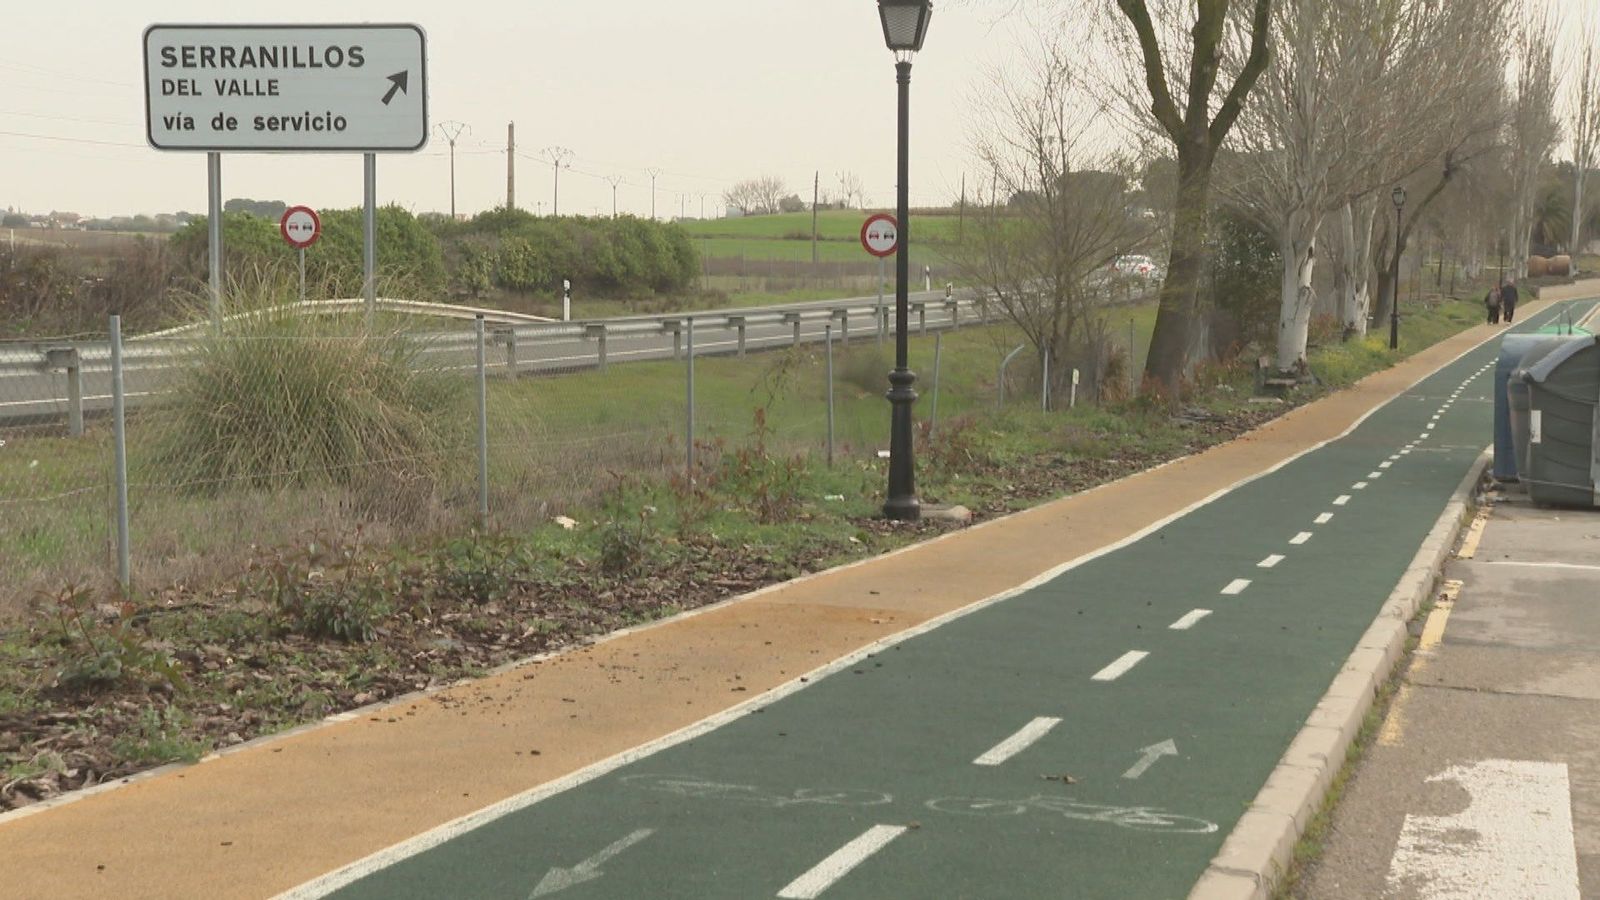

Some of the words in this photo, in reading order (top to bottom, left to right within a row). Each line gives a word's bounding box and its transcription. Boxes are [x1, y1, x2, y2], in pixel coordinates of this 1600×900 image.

[160, 45, 365, 69] SERRANILLOS
[161, 78, 203, 97] DEL
[214, 78, 280, 97] VALLE
[162, 111, 196, 131] vía
[210, 111, 239, 131] de
[253, 110, 347, 132] servicio
